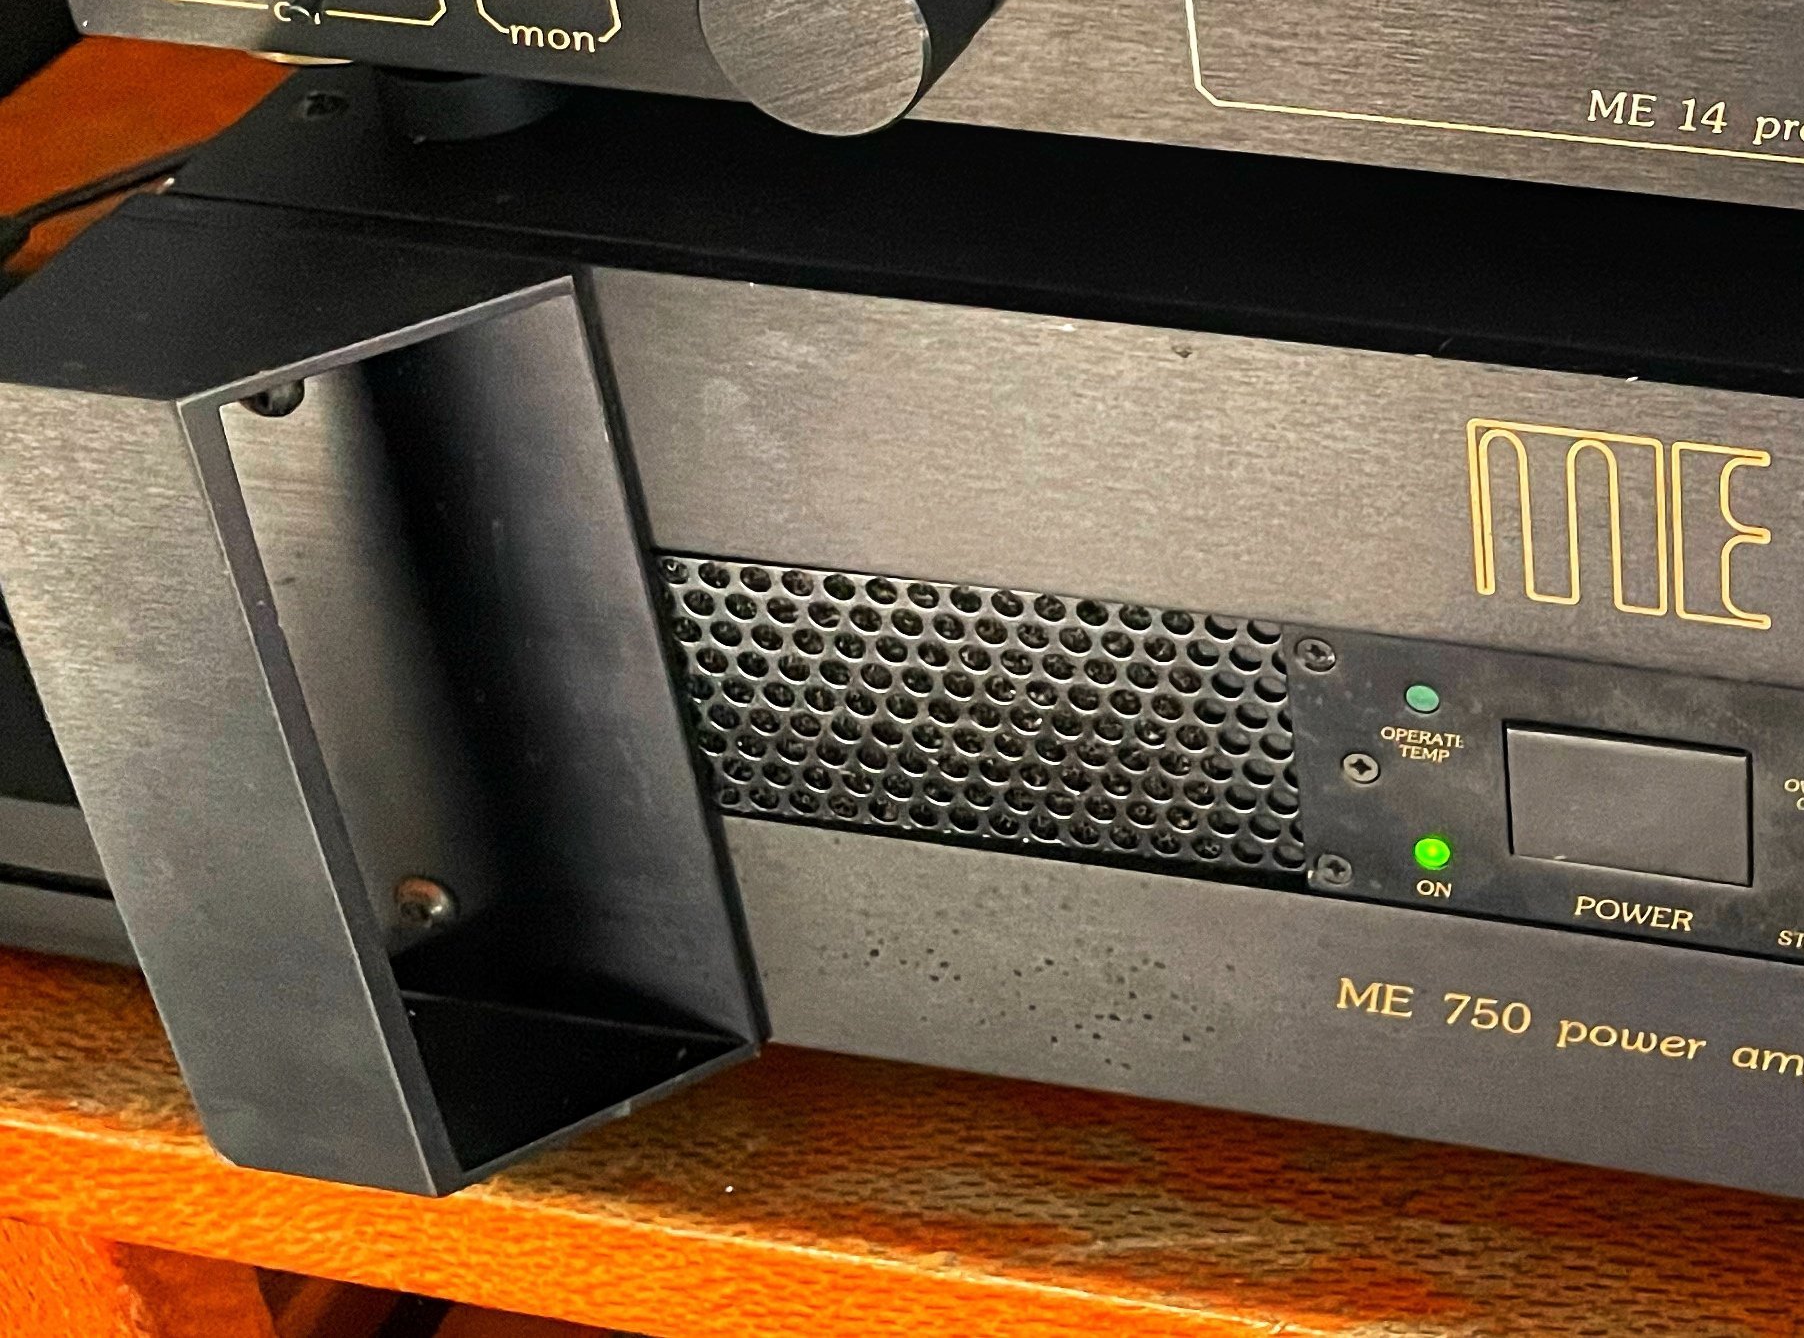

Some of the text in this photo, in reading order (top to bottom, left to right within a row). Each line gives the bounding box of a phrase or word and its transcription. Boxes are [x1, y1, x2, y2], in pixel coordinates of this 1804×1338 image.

[510, 23, 599, 53] mon
[1586, 89, 1658, 128] ME
[1678, 98, 1728, 134] 14
[1398, 743, 1451, 763] TEMP
[1416, 879, 1452, 898] ON
[1573, 895, 1695, 933] POWER
[1336, 978, 1414, 1019] ME
[1443, 992, 1532, 1035] 750
[1556, 1014, 1706, 1062] power
